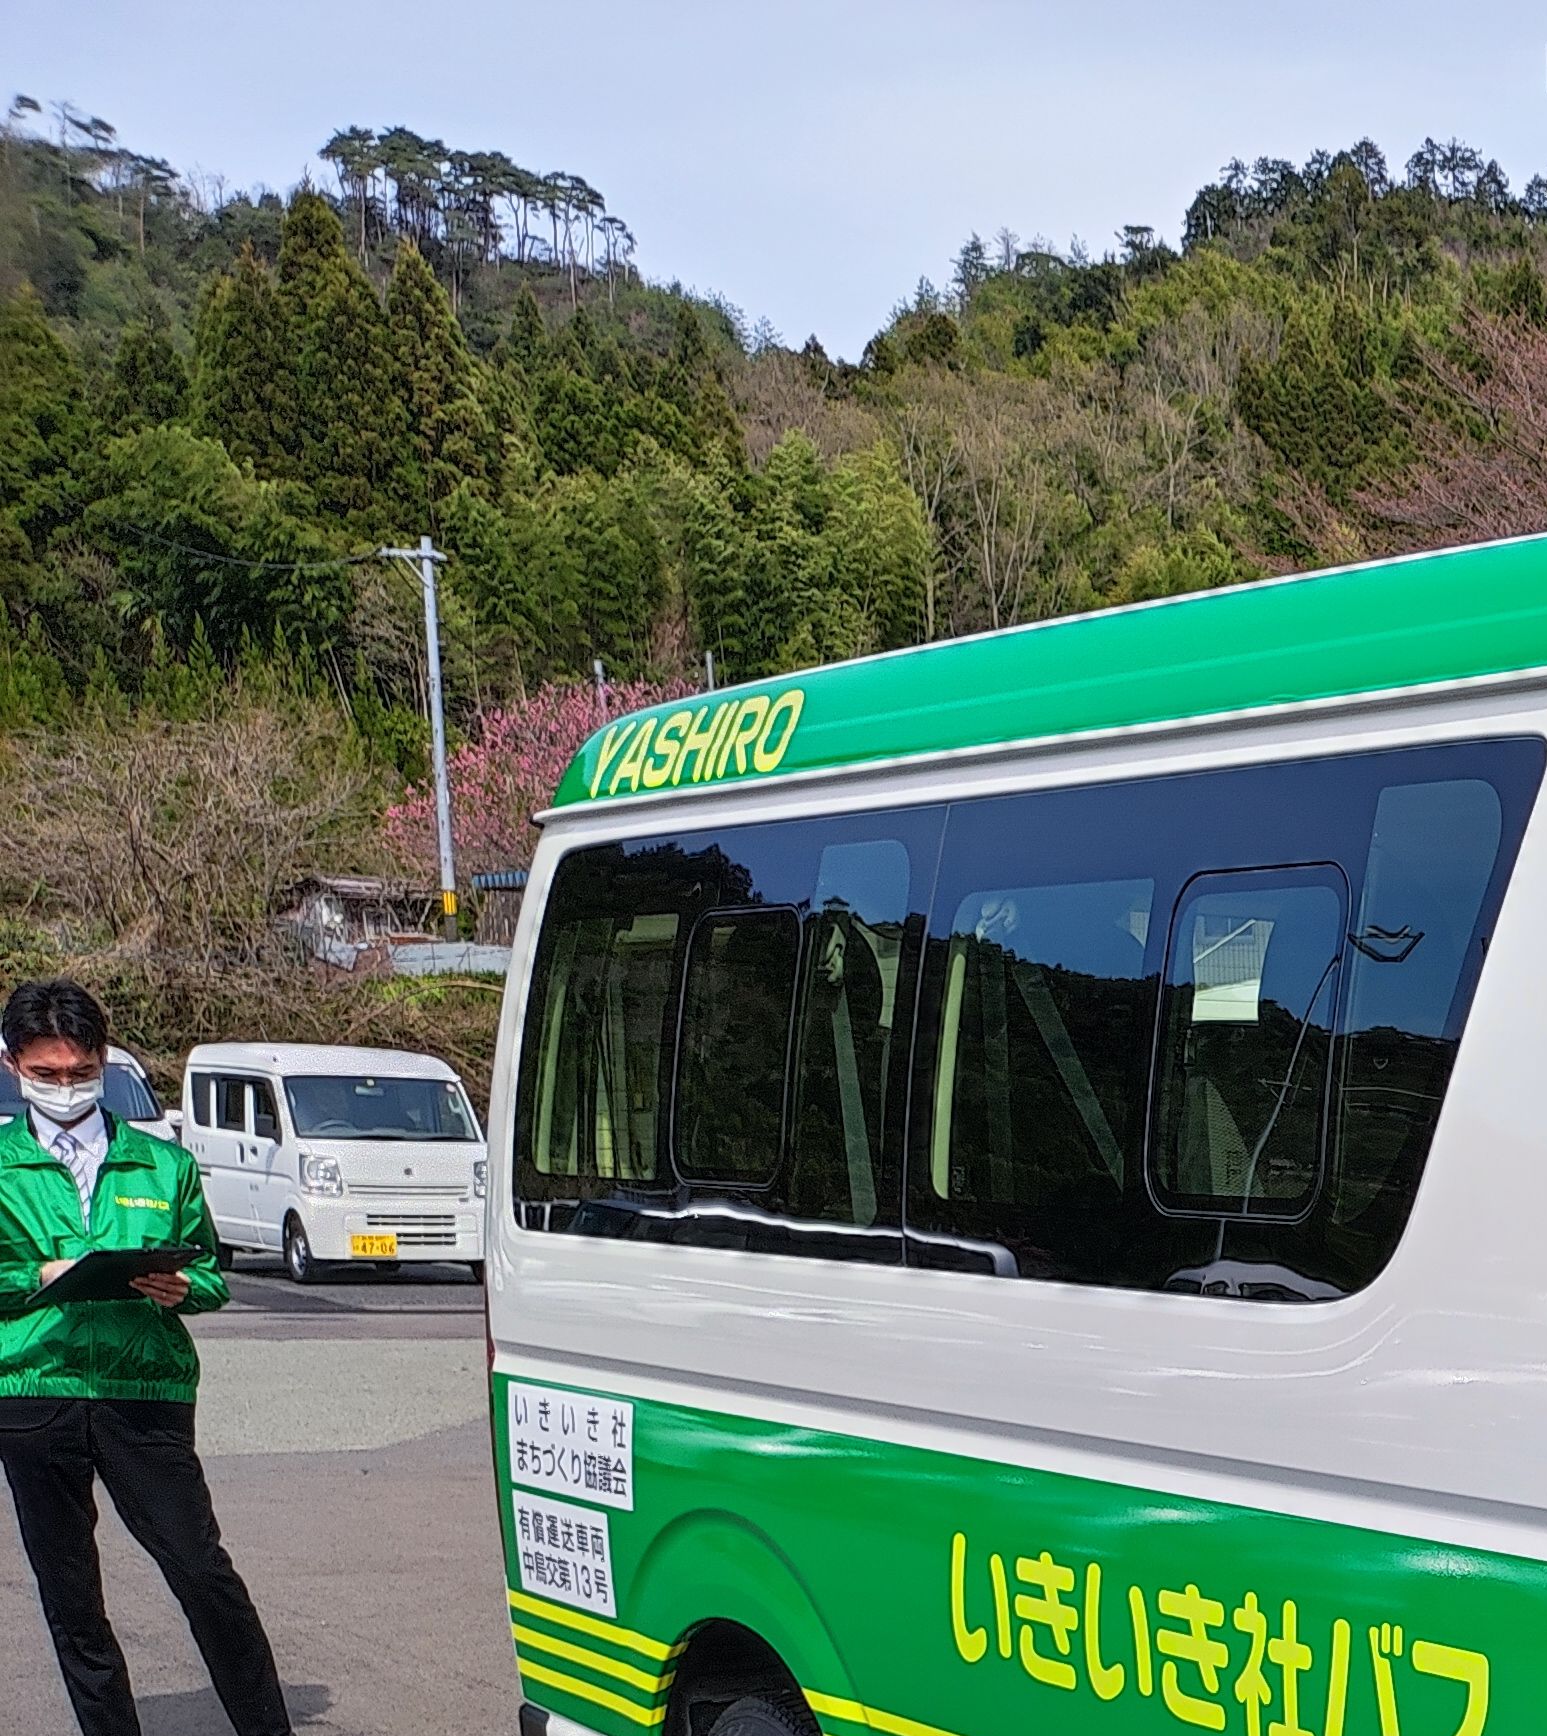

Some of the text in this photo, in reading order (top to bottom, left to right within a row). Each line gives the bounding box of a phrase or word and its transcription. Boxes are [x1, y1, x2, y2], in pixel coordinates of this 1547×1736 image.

[589, 690, 804, 799] YASHIRO
[514, 1394, 626, 1449] いきいき社
[516, 1437, 627, 1497] まちづくり協議会
